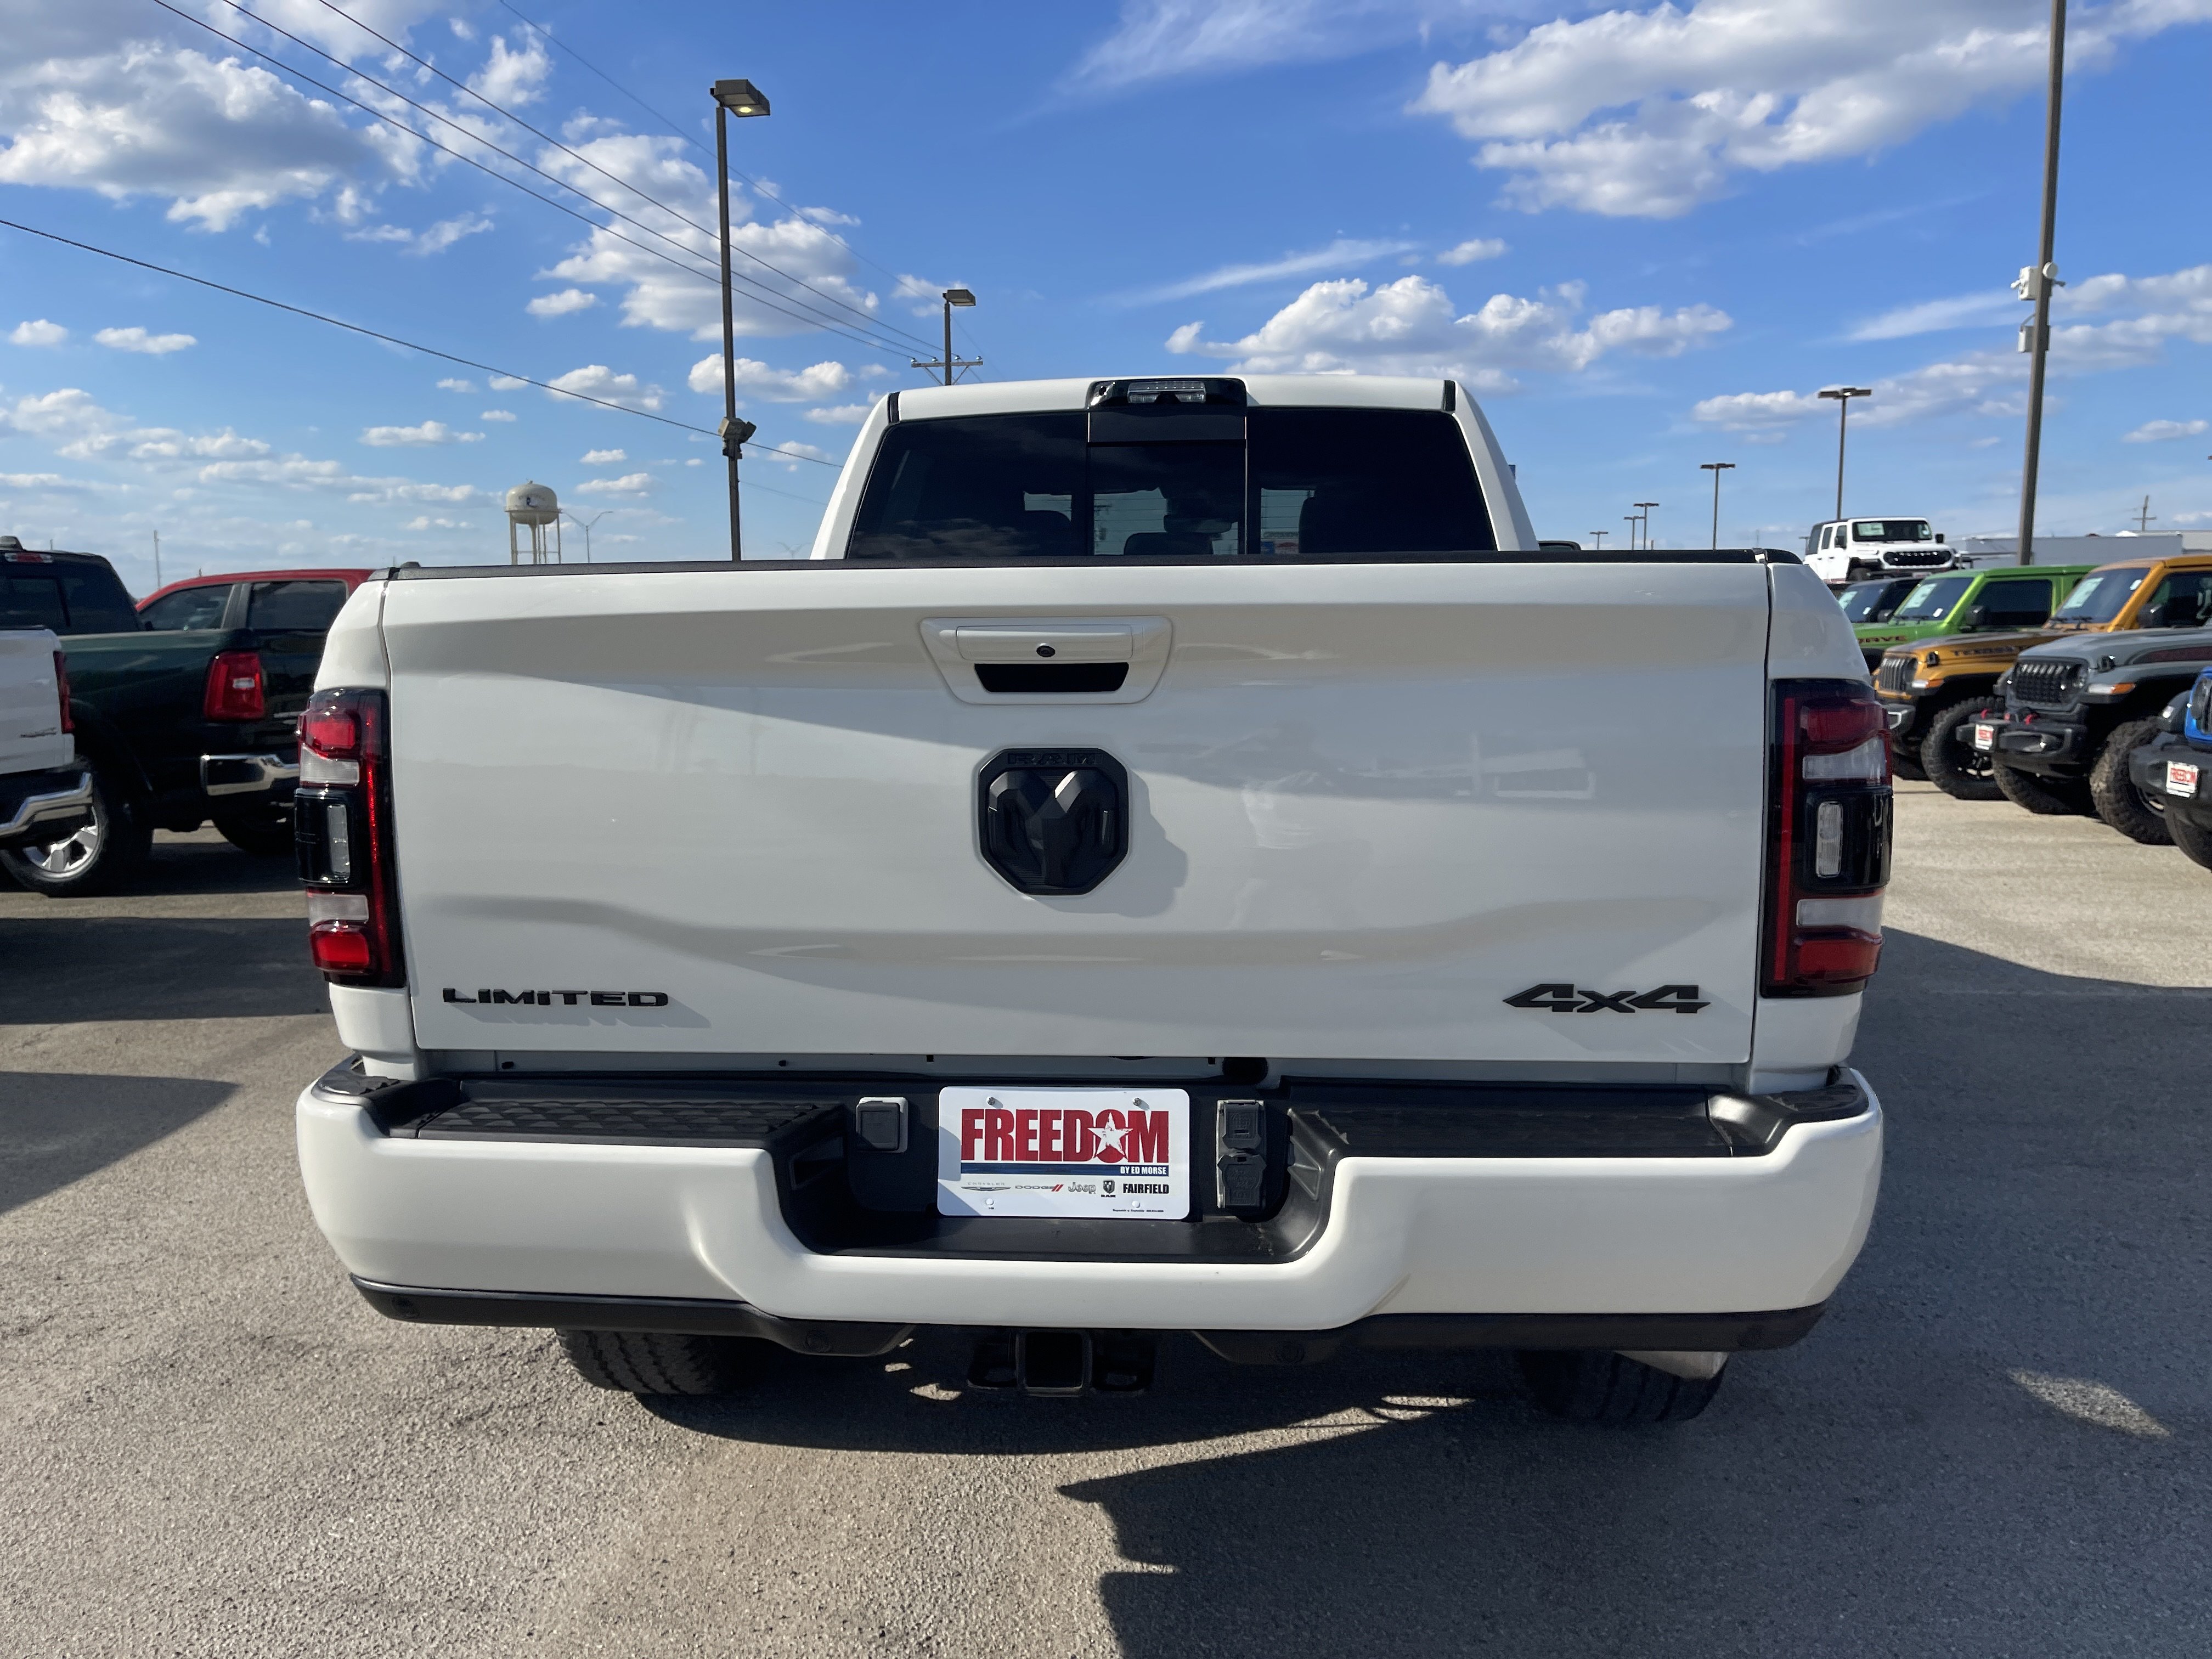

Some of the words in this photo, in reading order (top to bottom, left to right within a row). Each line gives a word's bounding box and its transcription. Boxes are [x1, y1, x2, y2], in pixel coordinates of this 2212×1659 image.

[1008, 753, 1104, 765] RAM
[443, 988, 668, 1007] LIMITED
[1503, 984, 1711, 1013] 4x4
[961, 1108, 1169, 1163] FREEDOM
[1120, 1166, 1130, 1174] BY
[1141, 1166, 1167, 1175] MORSE
[1068, 1182, 1096, 1194] Jeep
[1123, 1183, 1170, 1194] FAIRFIELD
